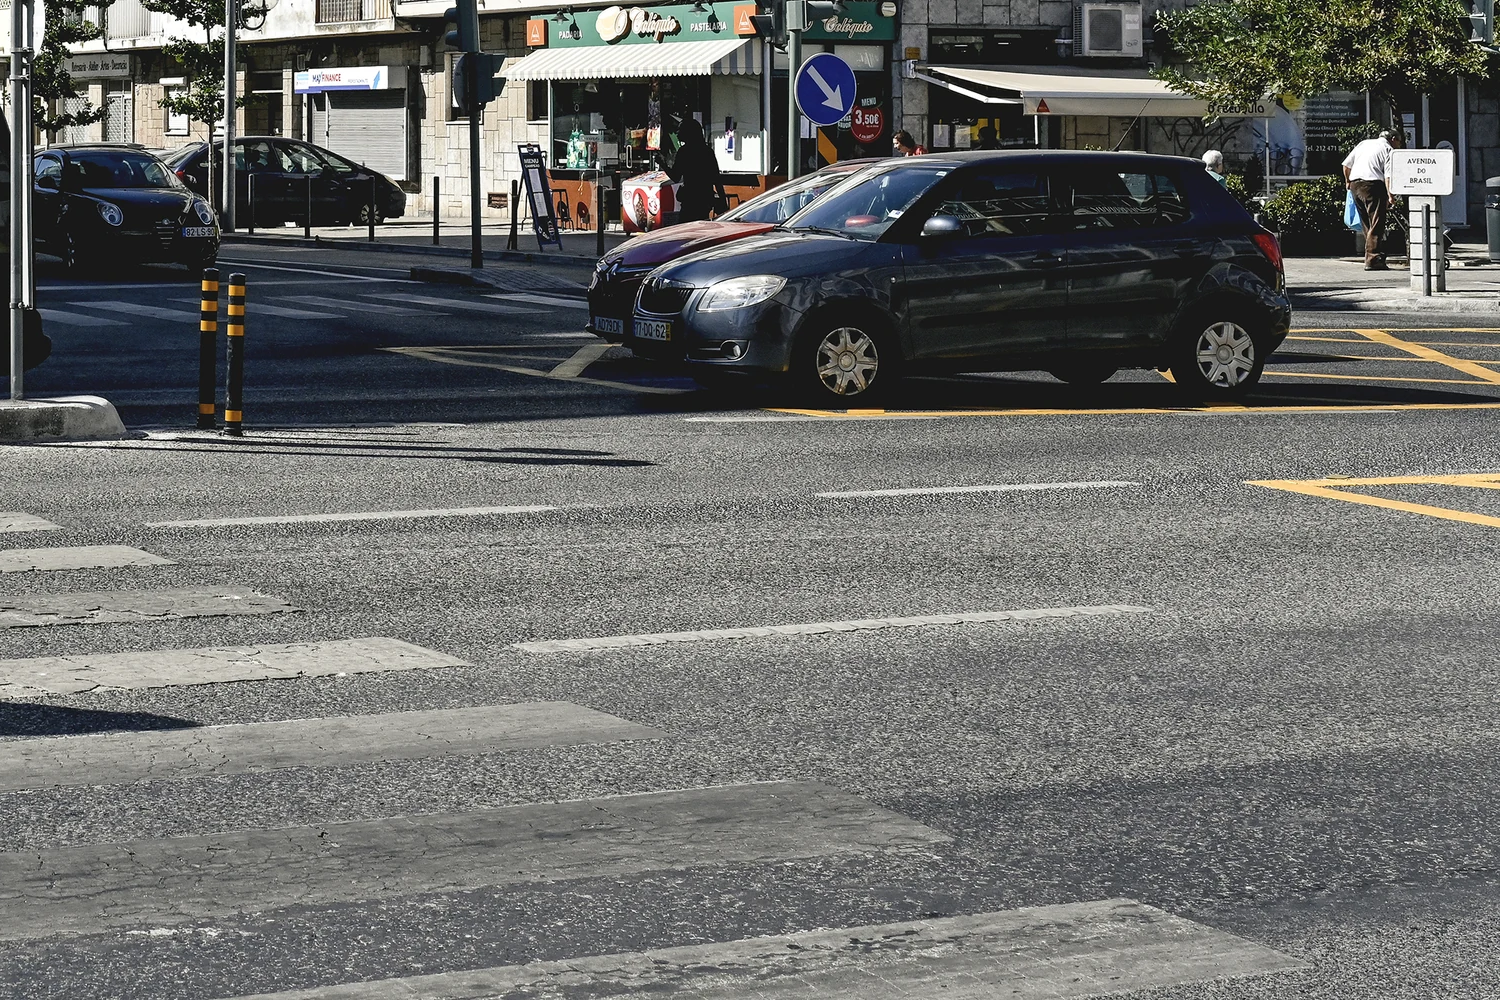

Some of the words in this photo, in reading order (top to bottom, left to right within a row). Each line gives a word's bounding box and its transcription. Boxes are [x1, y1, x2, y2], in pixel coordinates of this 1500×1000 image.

[690, 21, 727, 33] PASTELARIA
[558, 29, 584, 40] PADARIA
[854, 109, 880, 125] 3,50€
[1407, 157, 1437, 165] AVENIDA
